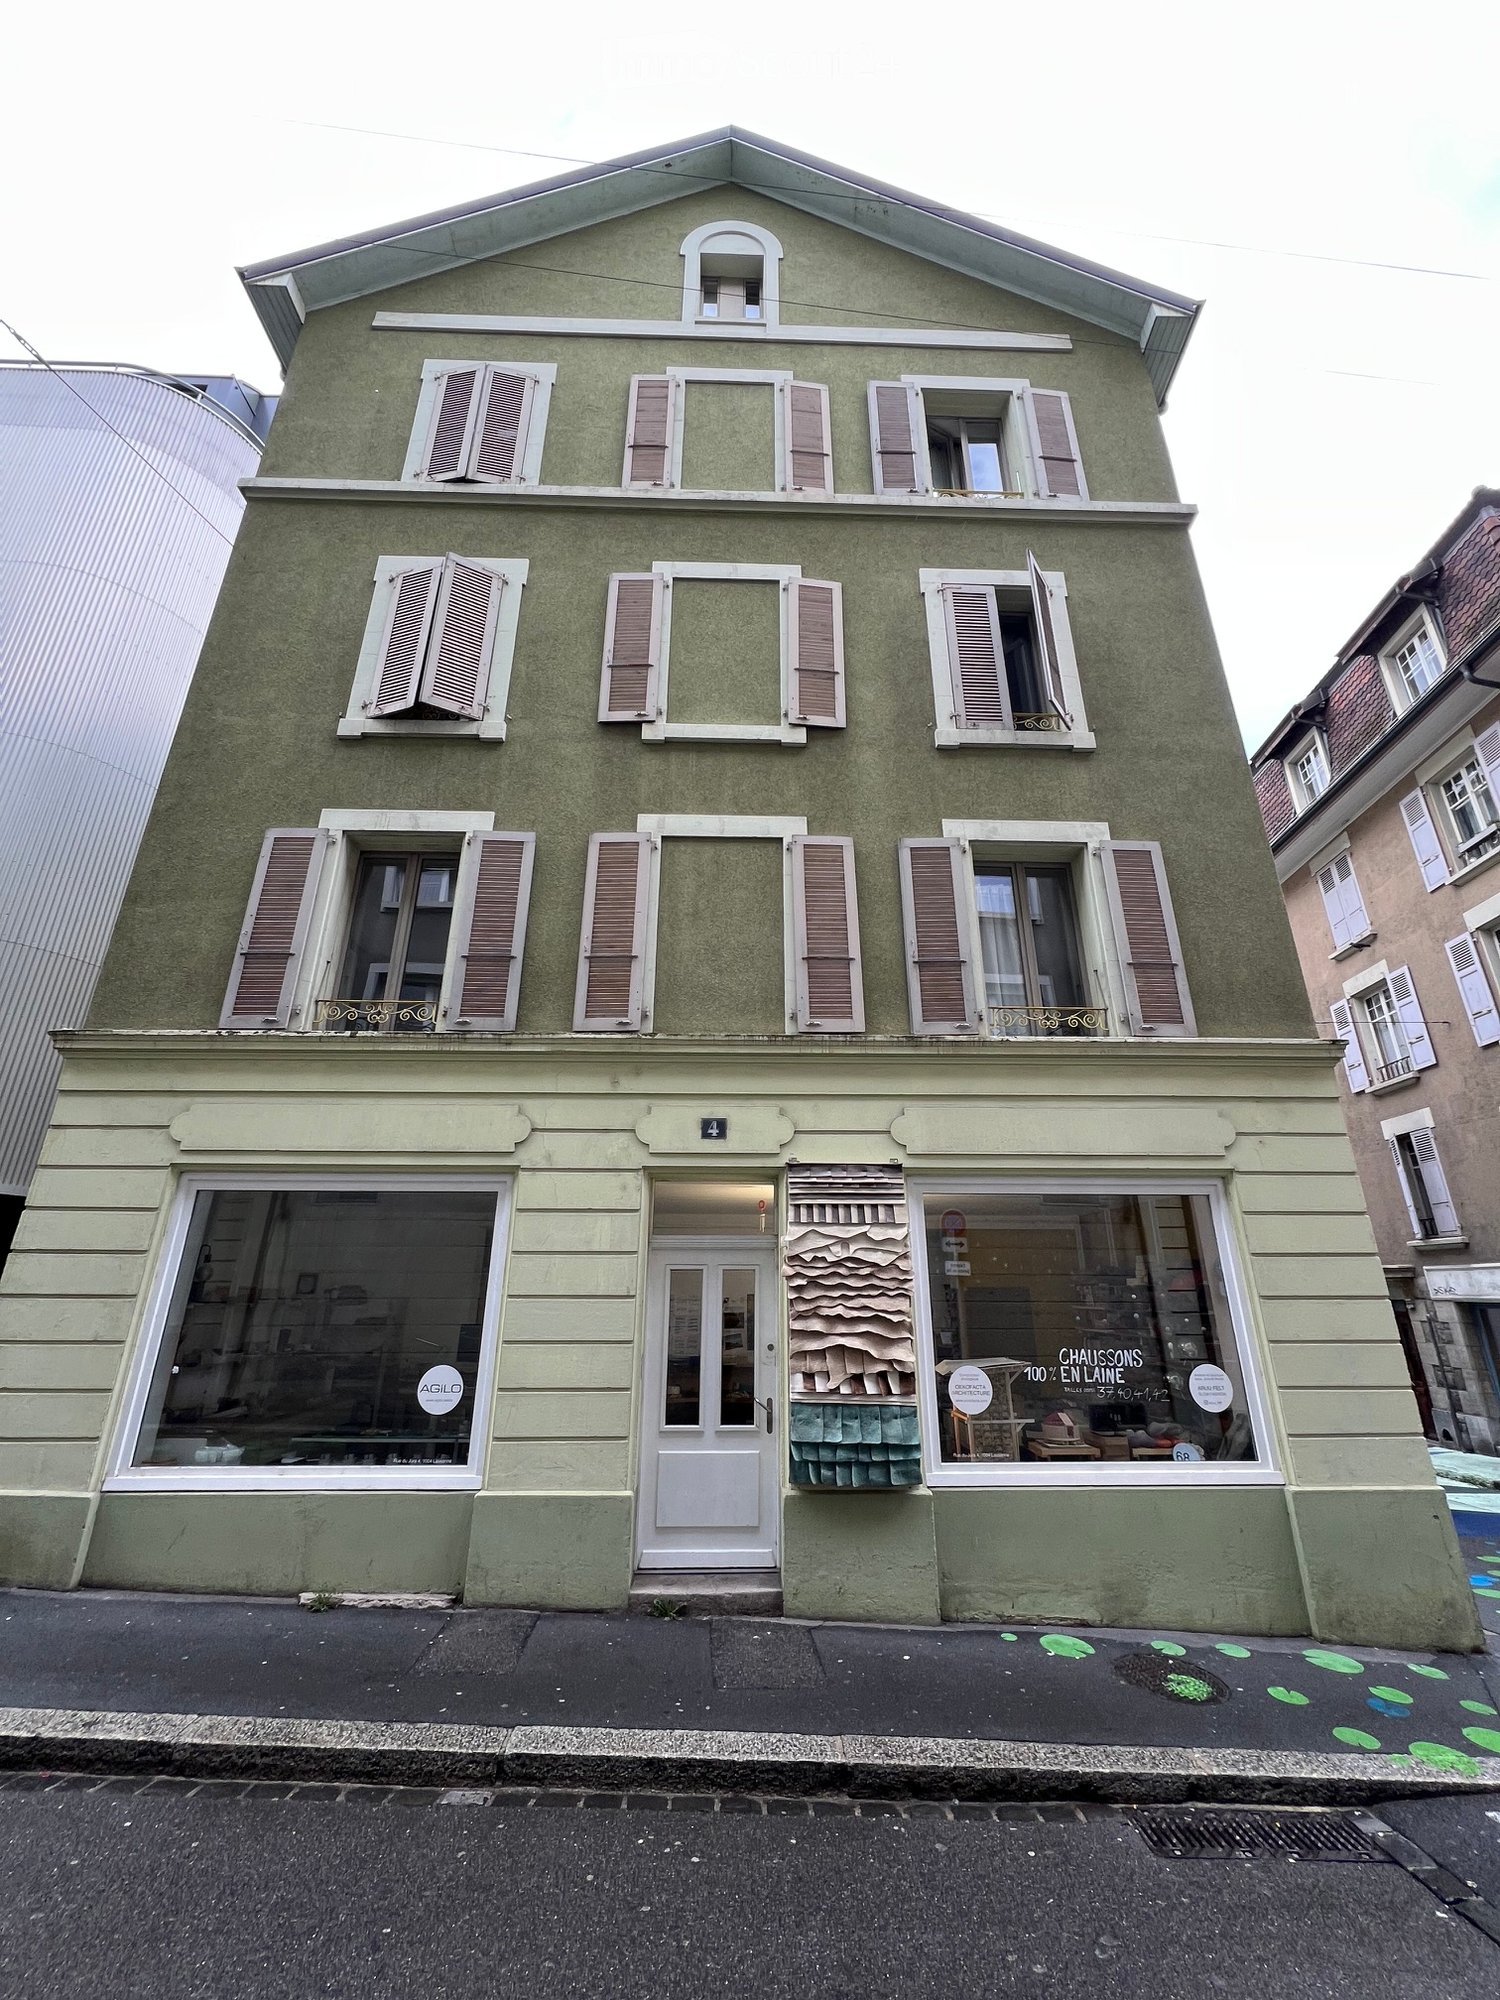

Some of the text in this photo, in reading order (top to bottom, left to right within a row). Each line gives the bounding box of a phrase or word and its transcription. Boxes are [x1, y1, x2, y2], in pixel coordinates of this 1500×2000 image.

[706, 1120, 720, 1137] 4
[1059, 1347, 1143, 1367] CHAUSSONS
[1060, 1366, 1081, 1383] EN
[1084, 1366, 1126, 1384] LAINE
[419, 1383, 462, 1394] AGILO
